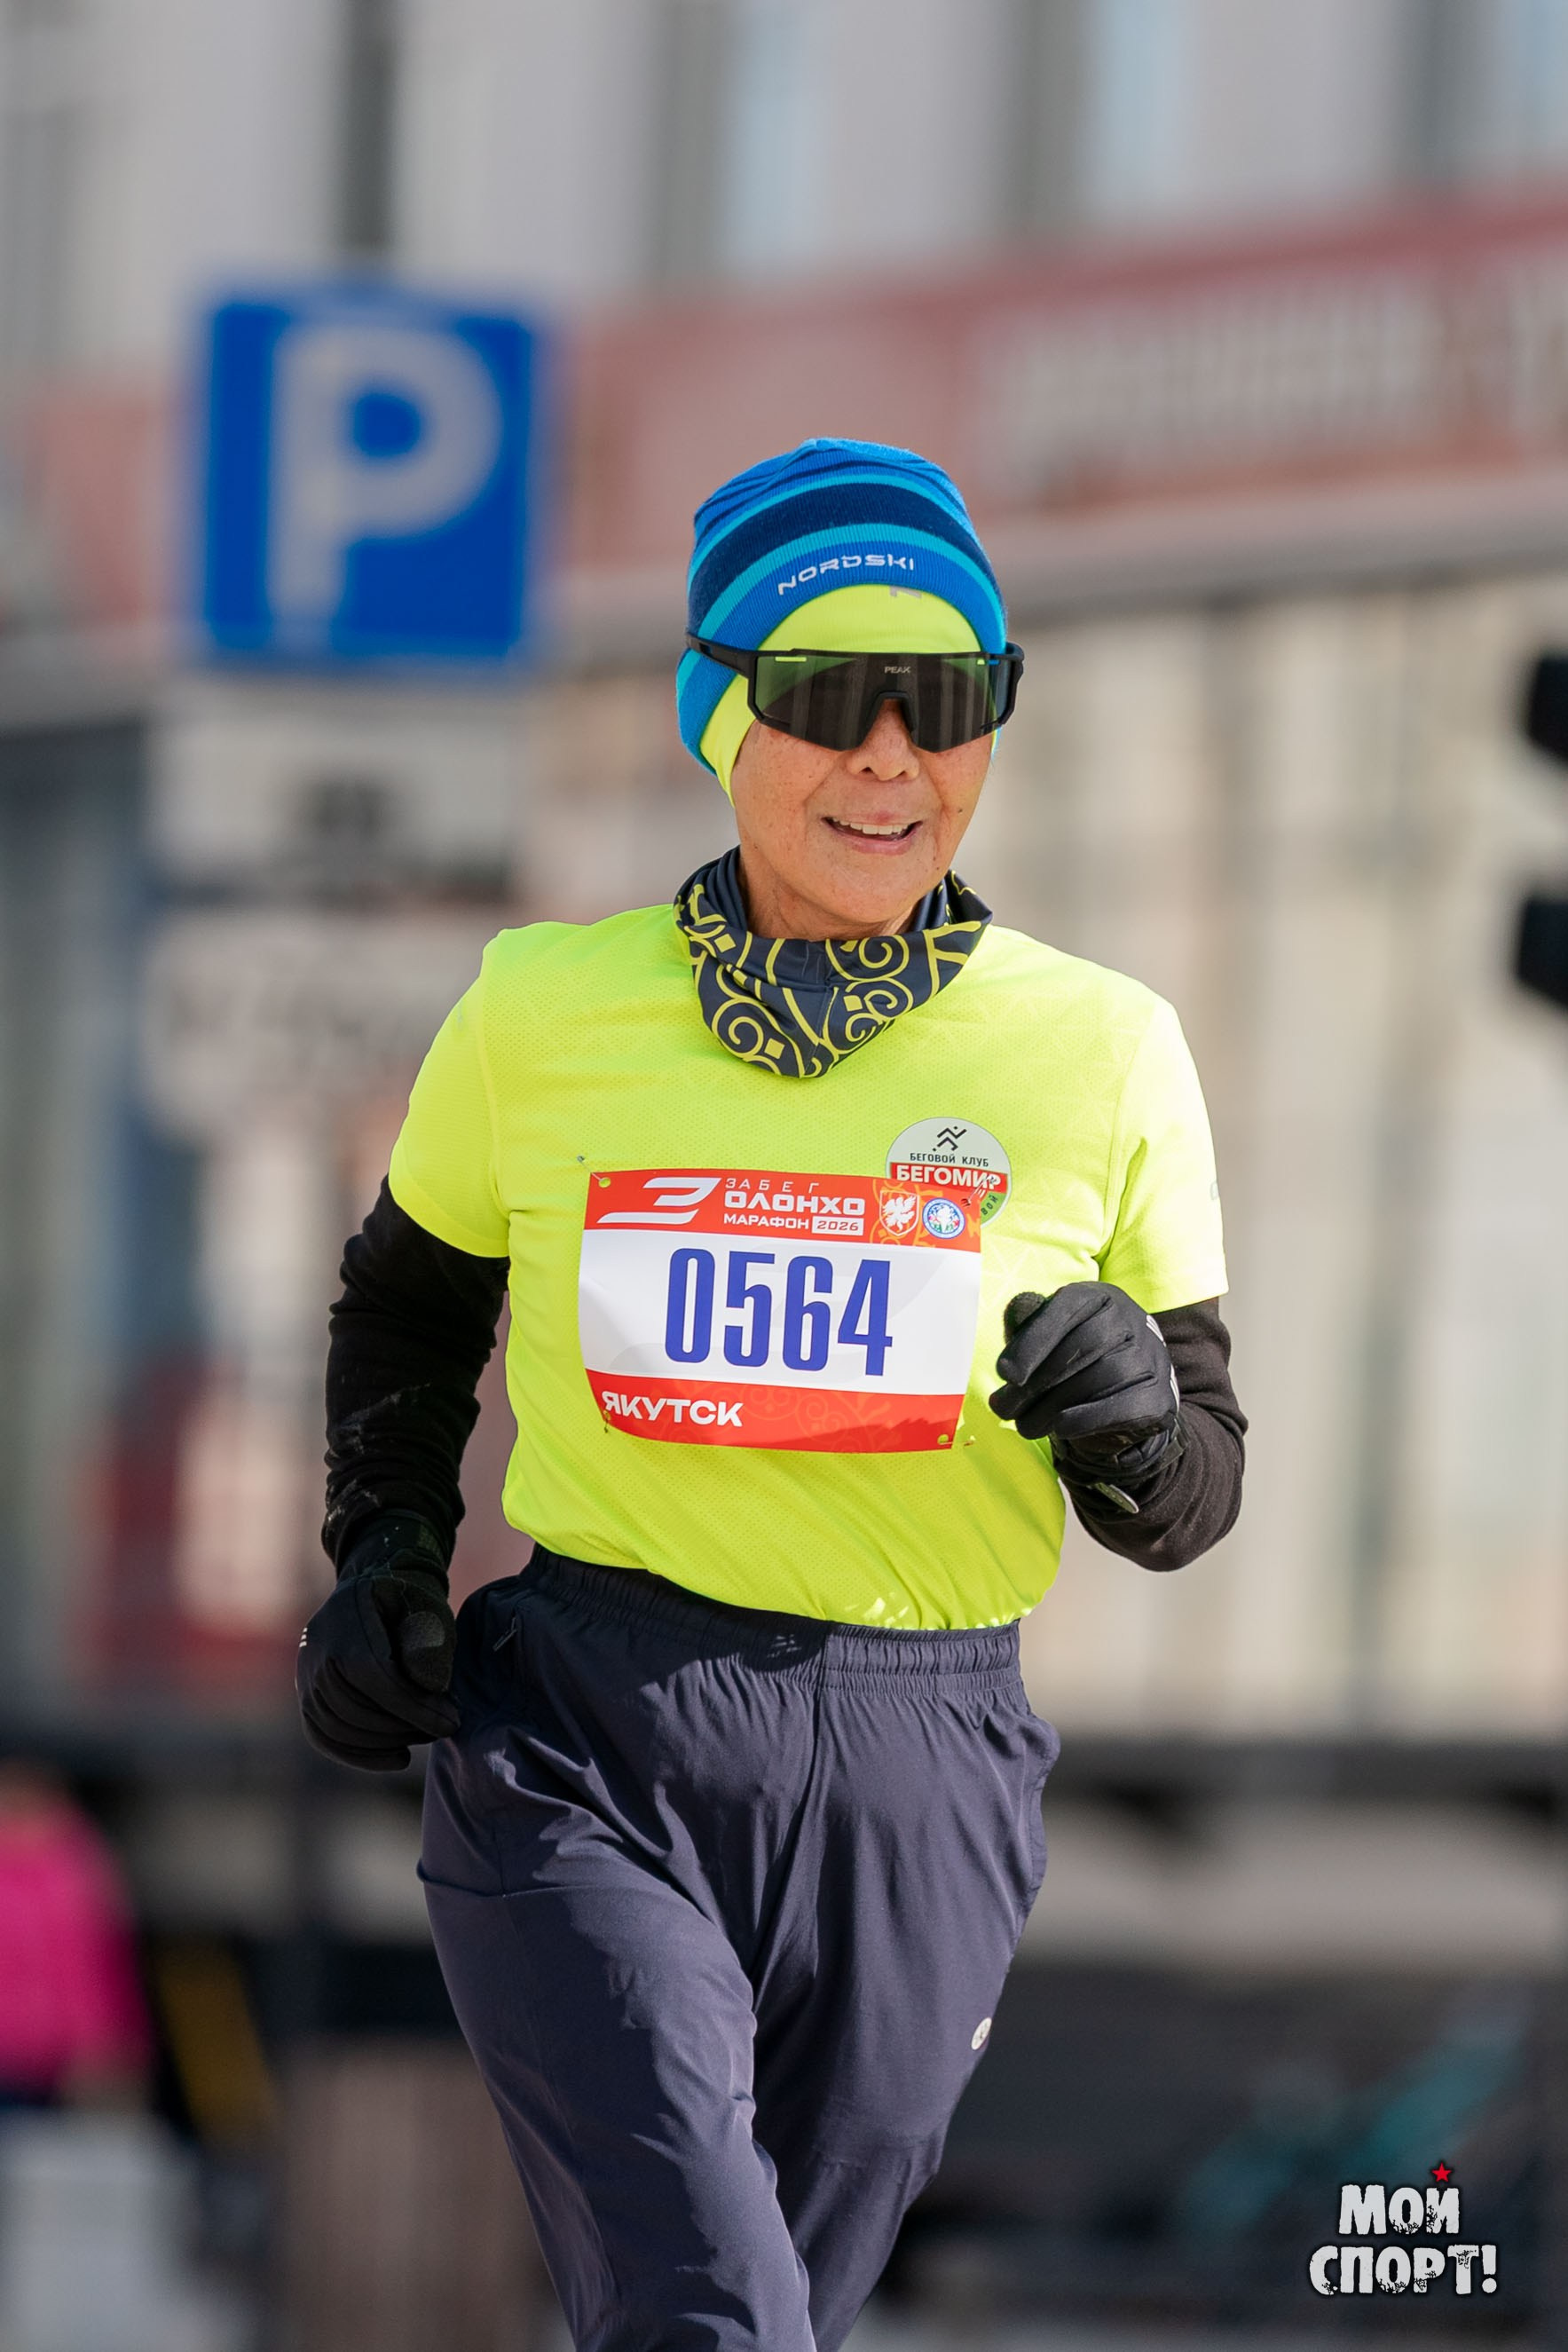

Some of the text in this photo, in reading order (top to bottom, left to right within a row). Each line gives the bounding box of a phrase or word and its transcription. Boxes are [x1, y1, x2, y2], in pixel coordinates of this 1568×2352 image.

[268, 325, 500, 634] P
[777, 553, 915, 596] NORDSKI
[910, 1152, 989, 1167] БЕГОВОЙ КЛУБ
[896, 1164, 1001, 1190] БЕГОМИР
[724, 1190, 865, 1216] ОЛОНХО
[723, 1213, 859, 1231] МАРАФОН 2026
[665, 1247, 893, 1377] 0564
[602, 1391, 743, 1427] ЯКУТСК
